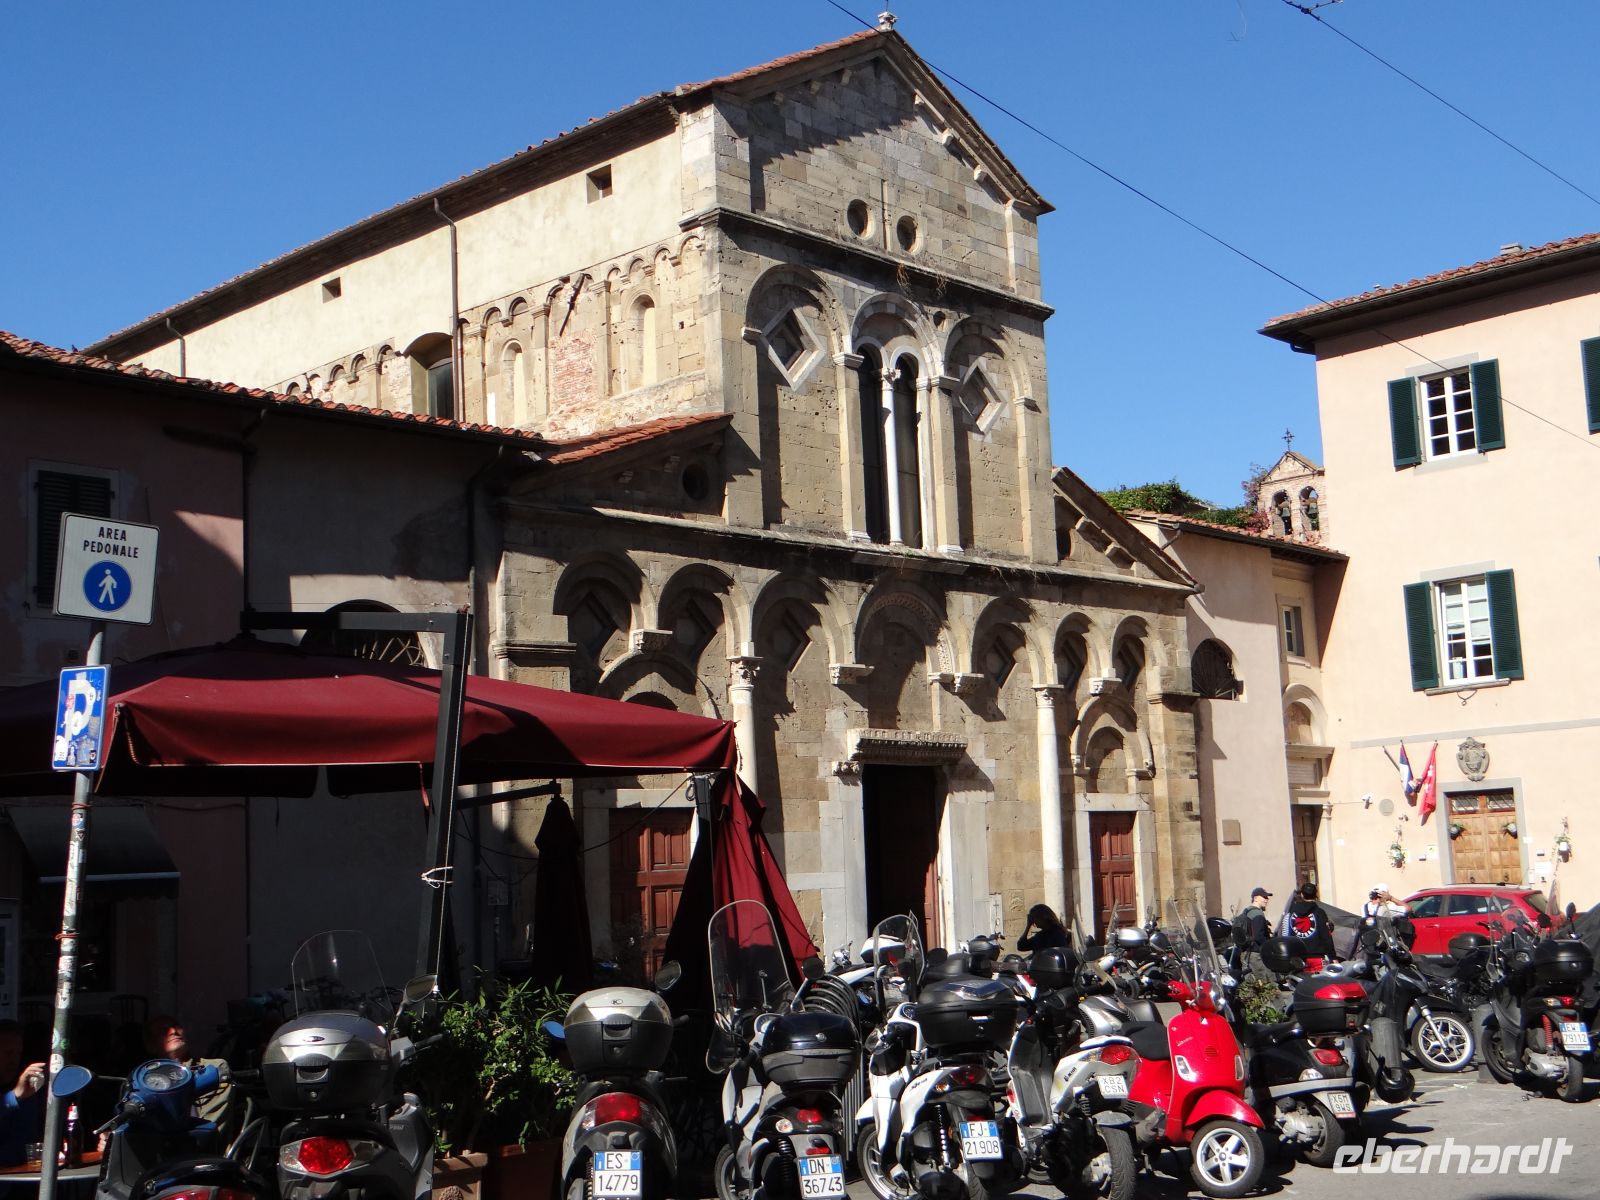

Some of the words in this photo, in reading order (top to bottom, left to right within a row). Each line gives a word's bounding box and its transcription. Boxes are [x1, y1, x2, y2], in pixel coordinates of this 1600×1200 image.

[98, 526, 127, 541] AREA
[83, 540, 139, 558] PEDONALE
[969, 1123, 984, 1137] FJ
[964, 1140, 1000, 1155] 21908
[606, 1152, 623, 1170] ES
[809, 1158, 826, 1174] DN
[598, 1174, 639, 1192] 14779
[803, 1176, 843, 1194] 36743
